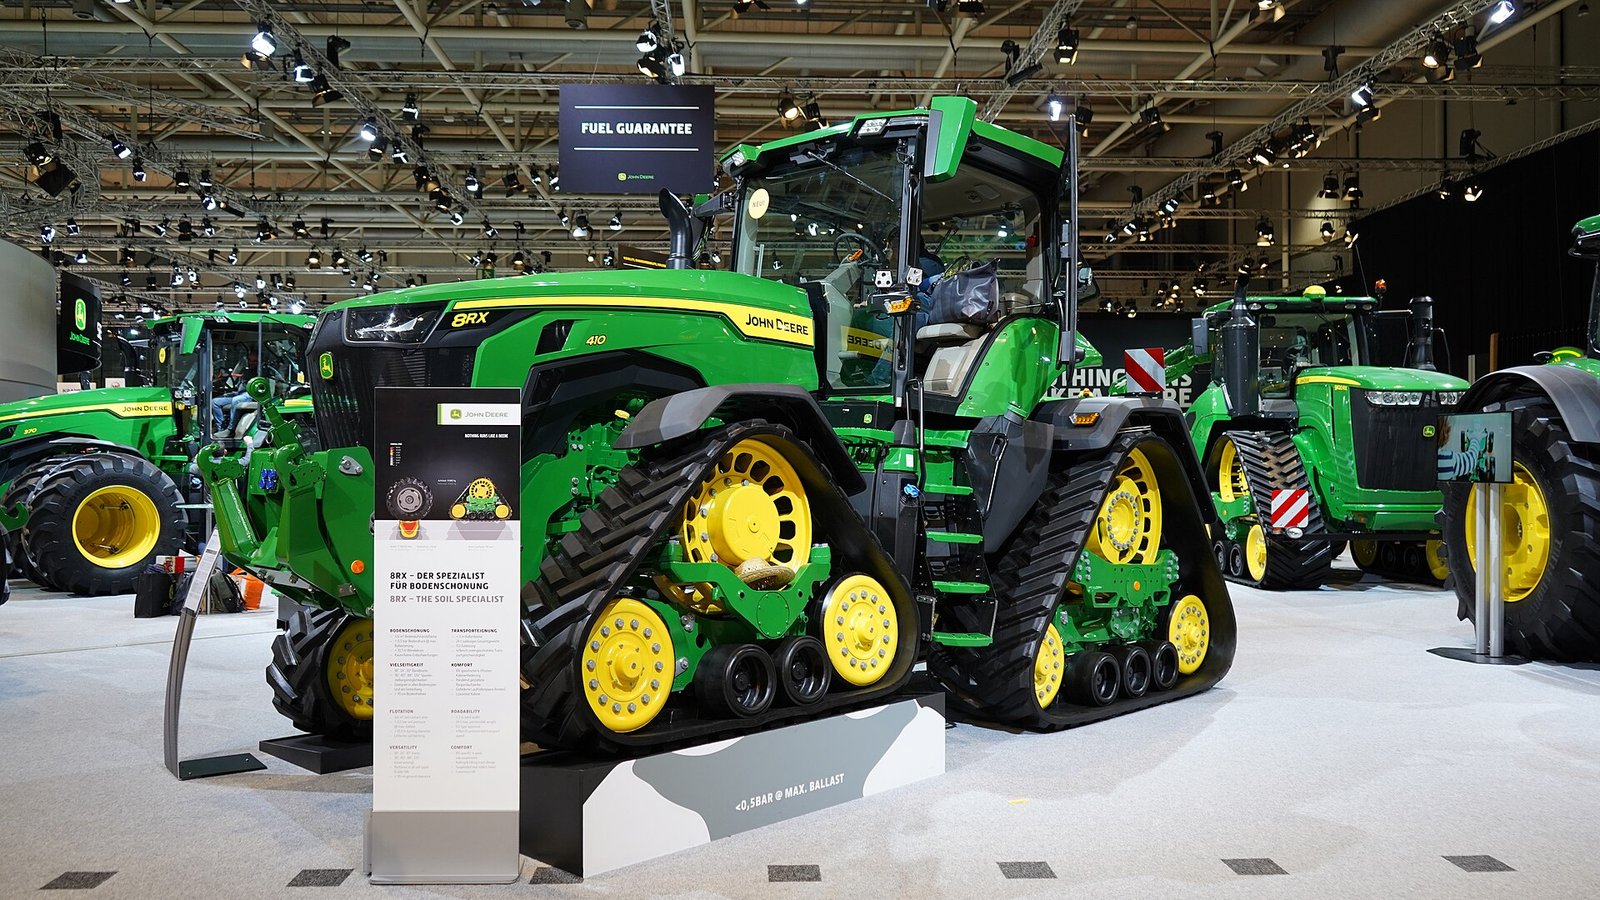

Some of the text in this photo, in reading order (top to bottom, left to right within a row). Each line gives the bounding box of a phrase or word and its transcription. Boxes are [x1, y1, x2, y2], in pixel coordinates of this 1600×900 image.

[582, 122, 692, 134] FUEL GUARANTEE
[451, 312, 490, 328] 8RX
[746, 314, 808, 336] JOHN DEERE
[586, 335, 607, 345] 410
[390, 580, 489, 590] FÜR BODENSCHONUNG
[736, 773, 844, 811] <0,5BAR @ MAX. BALLAST
